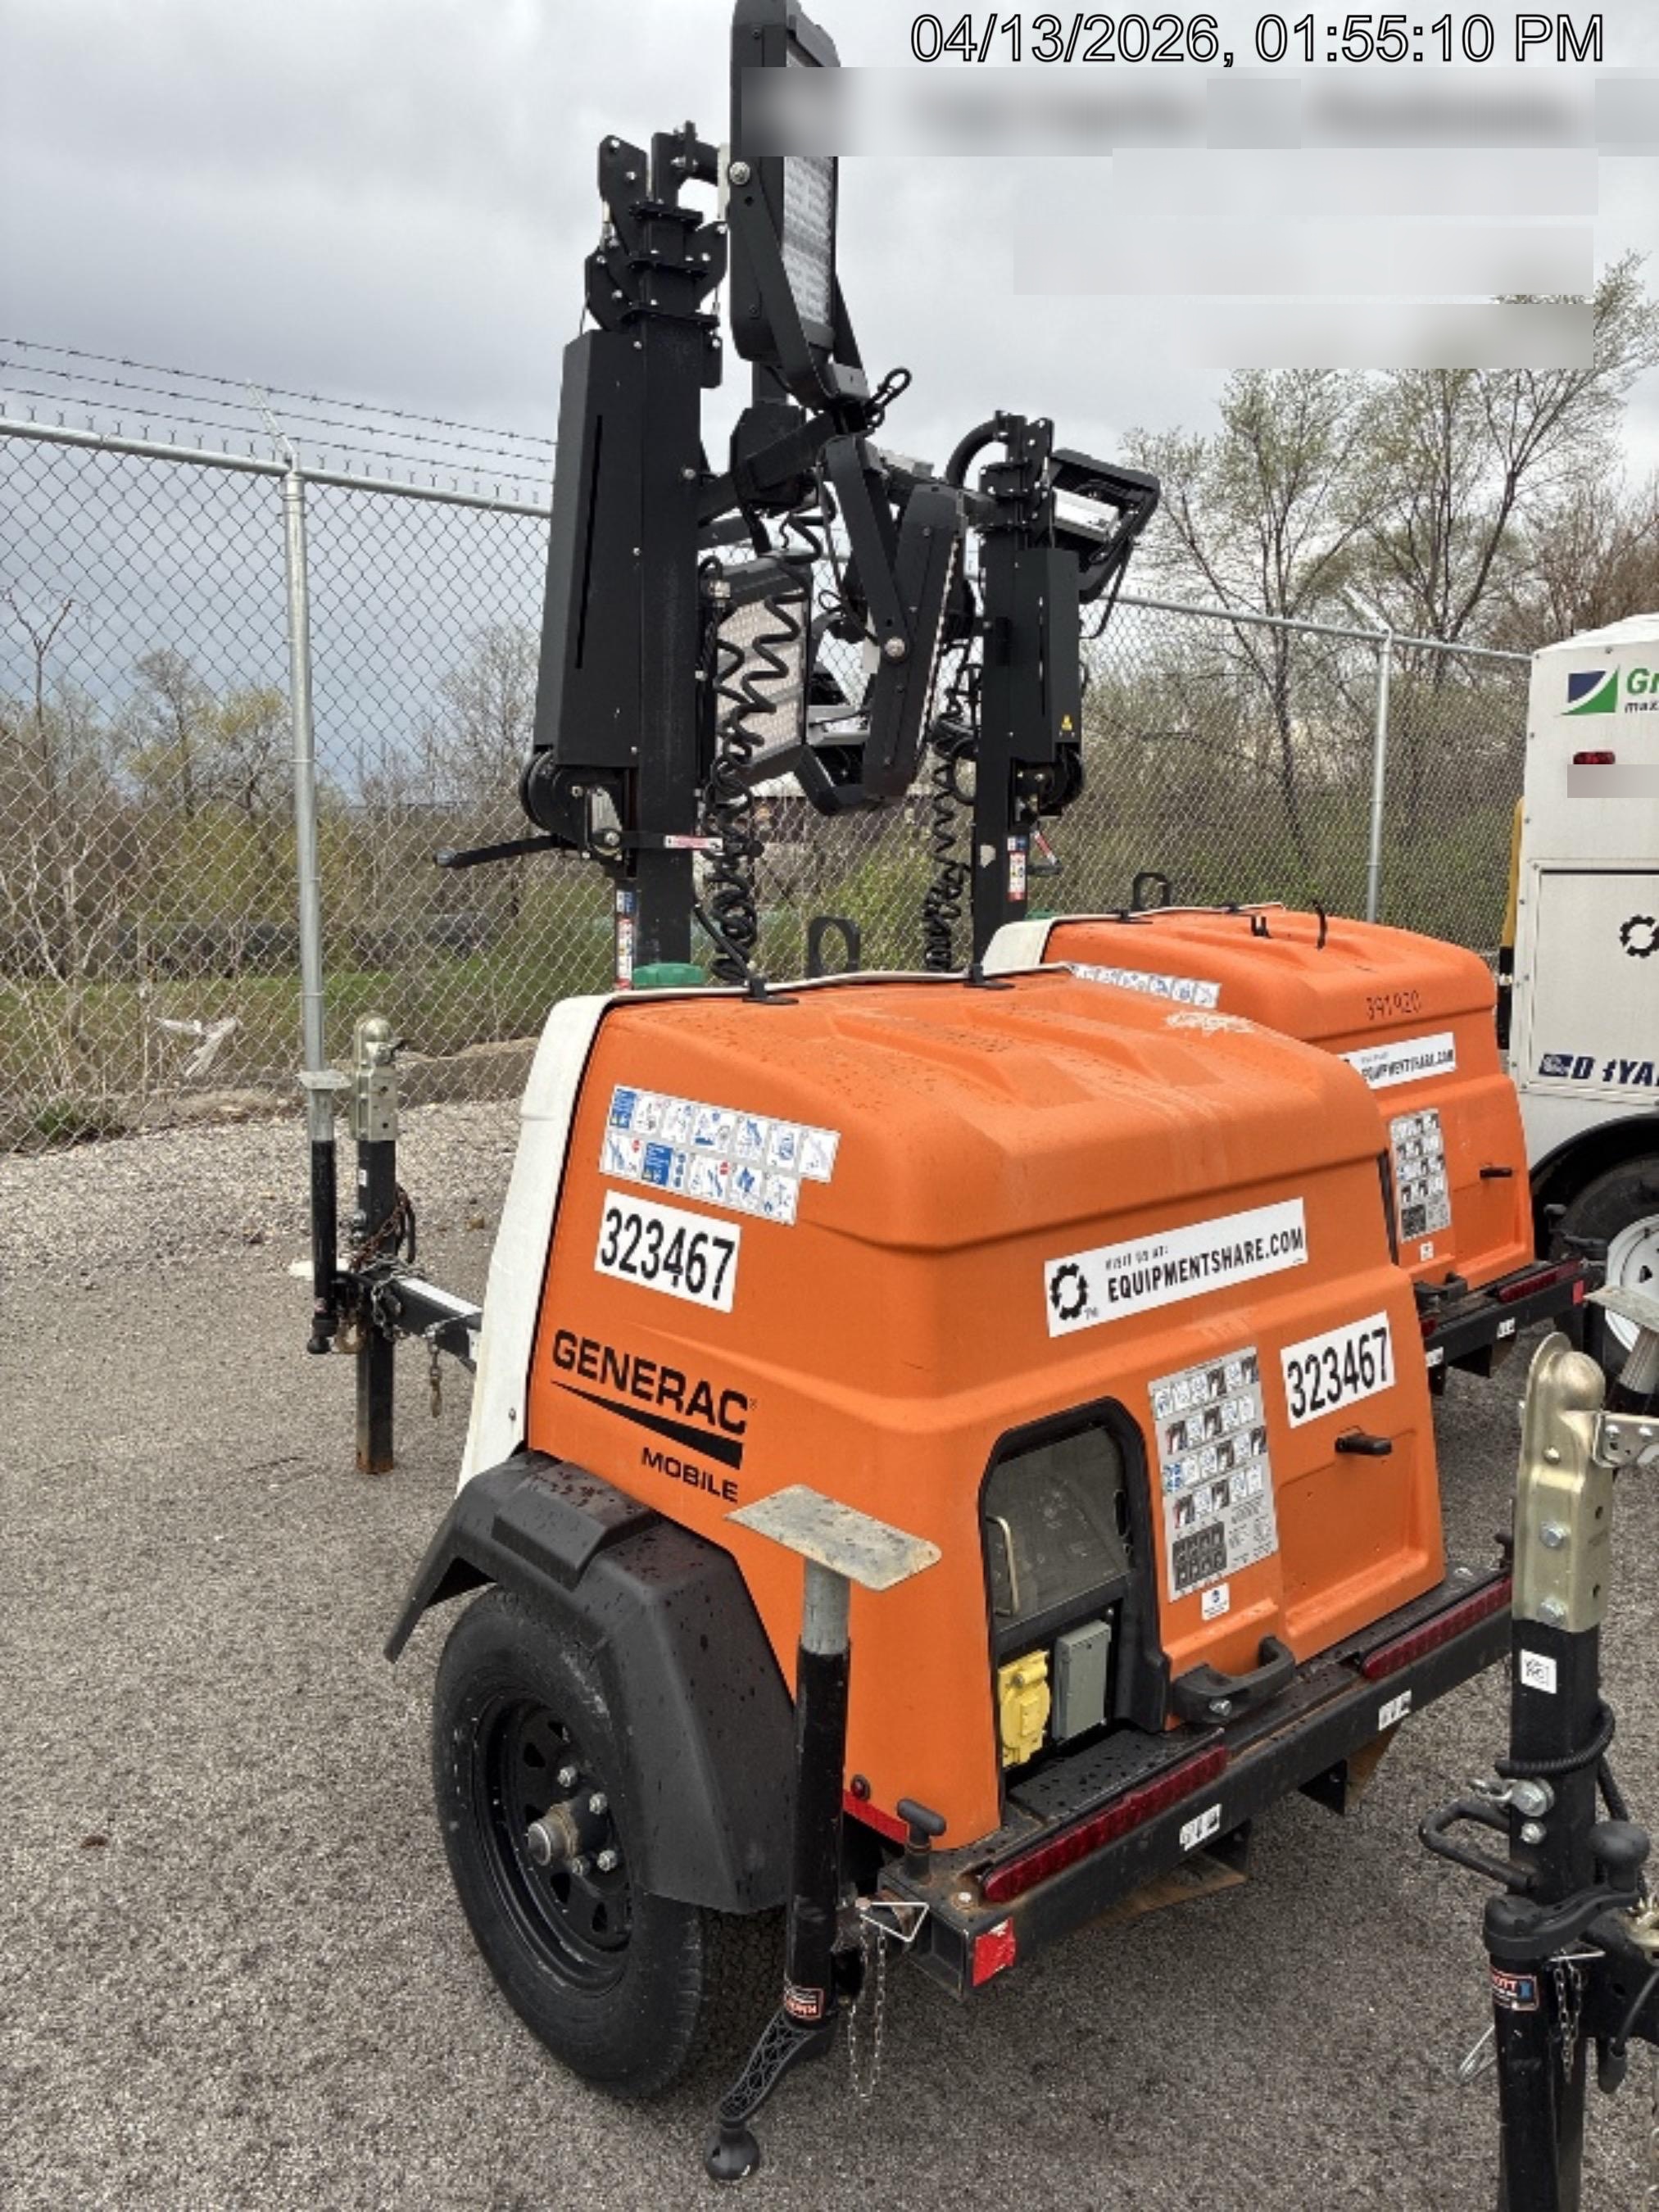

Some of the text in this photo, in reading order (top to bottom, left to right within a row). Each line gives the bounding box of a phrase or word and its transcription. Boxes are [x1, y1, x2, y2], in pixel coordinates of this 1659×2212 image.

[601, 1208, 735, 1301] 323467
[1108, 1226, 1303, 1303] EQUIPMENTSHARE.COM
[552, 1329, 748, 1436] GENERAC
[1288, 1327, 1387, 1419] 323467
[641, 1447, 738, 1504] MOBILE
